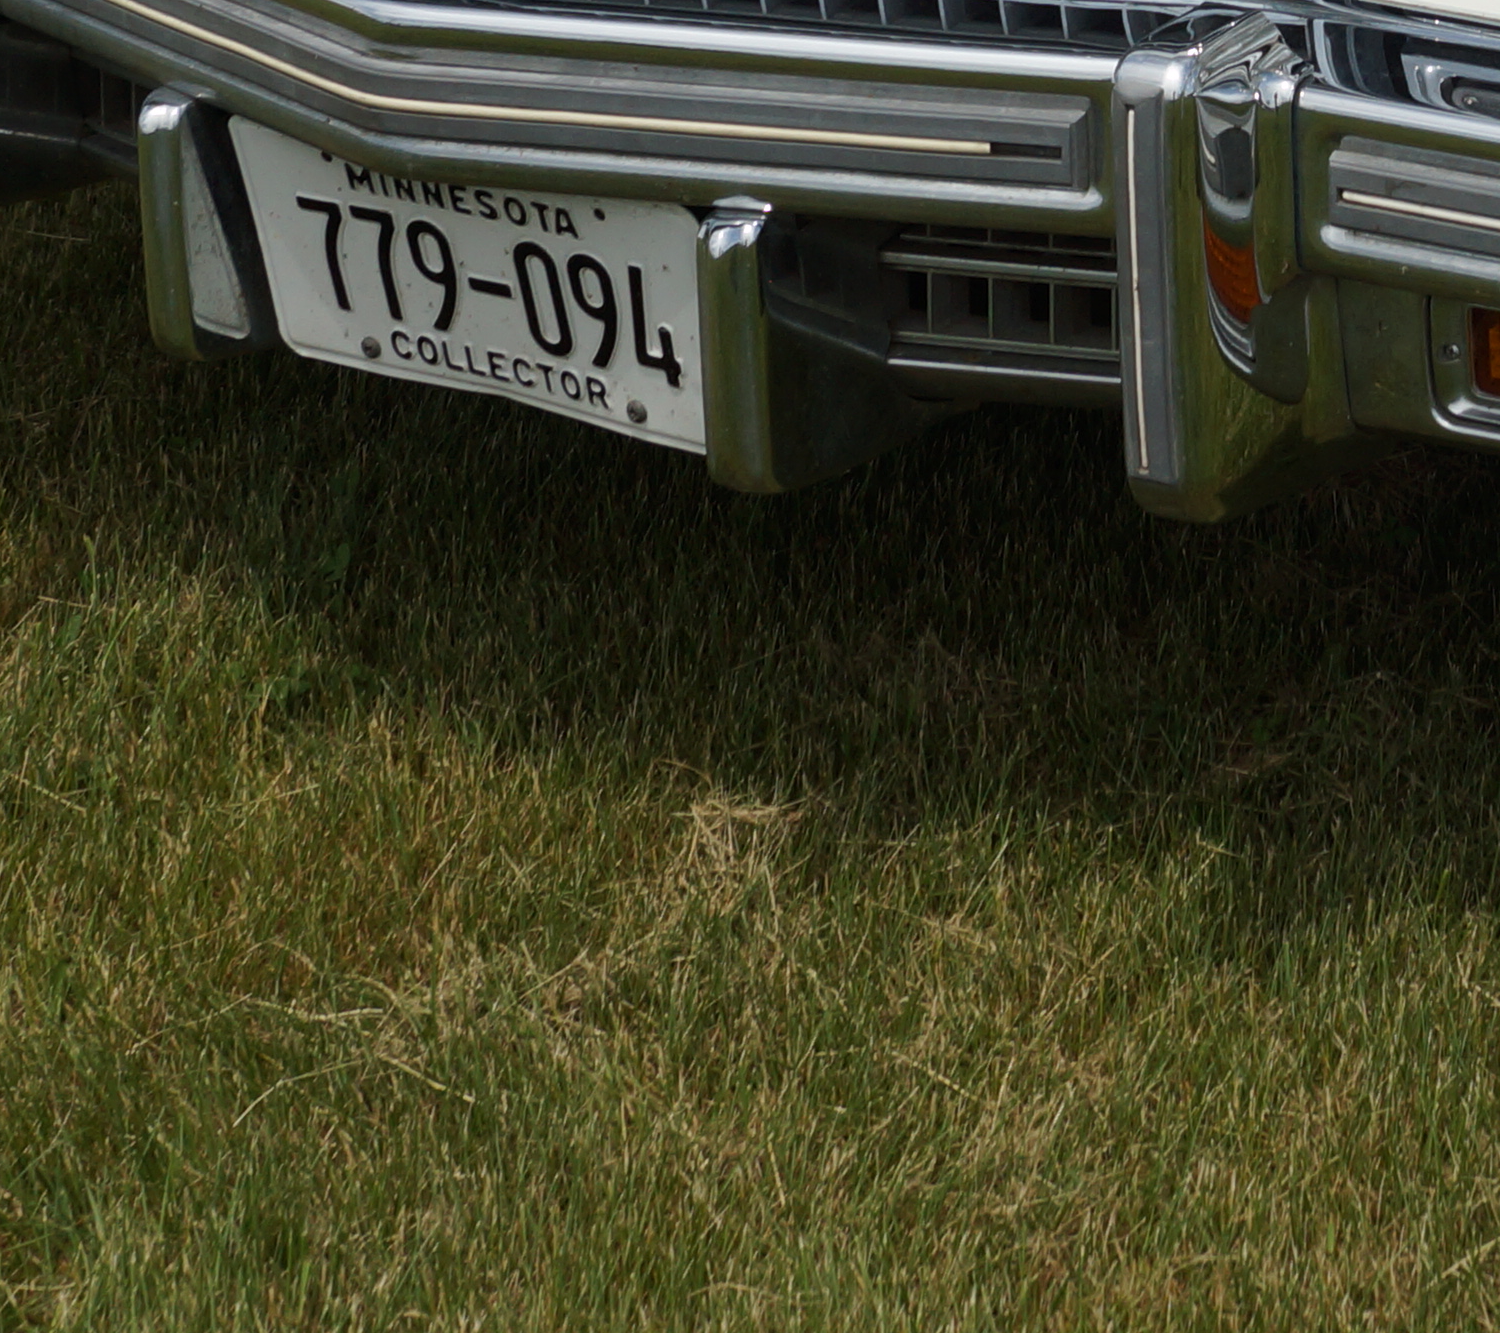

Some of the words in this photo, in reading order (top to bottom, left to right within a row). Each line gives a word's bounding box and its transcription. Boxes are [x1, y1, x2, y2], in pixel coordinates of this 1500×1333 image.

[343, 162, 580, 240] MINNESOTA
[295, 191, 683, 389] 779-094
[390, 330, 611, 410] COLLECTOR
